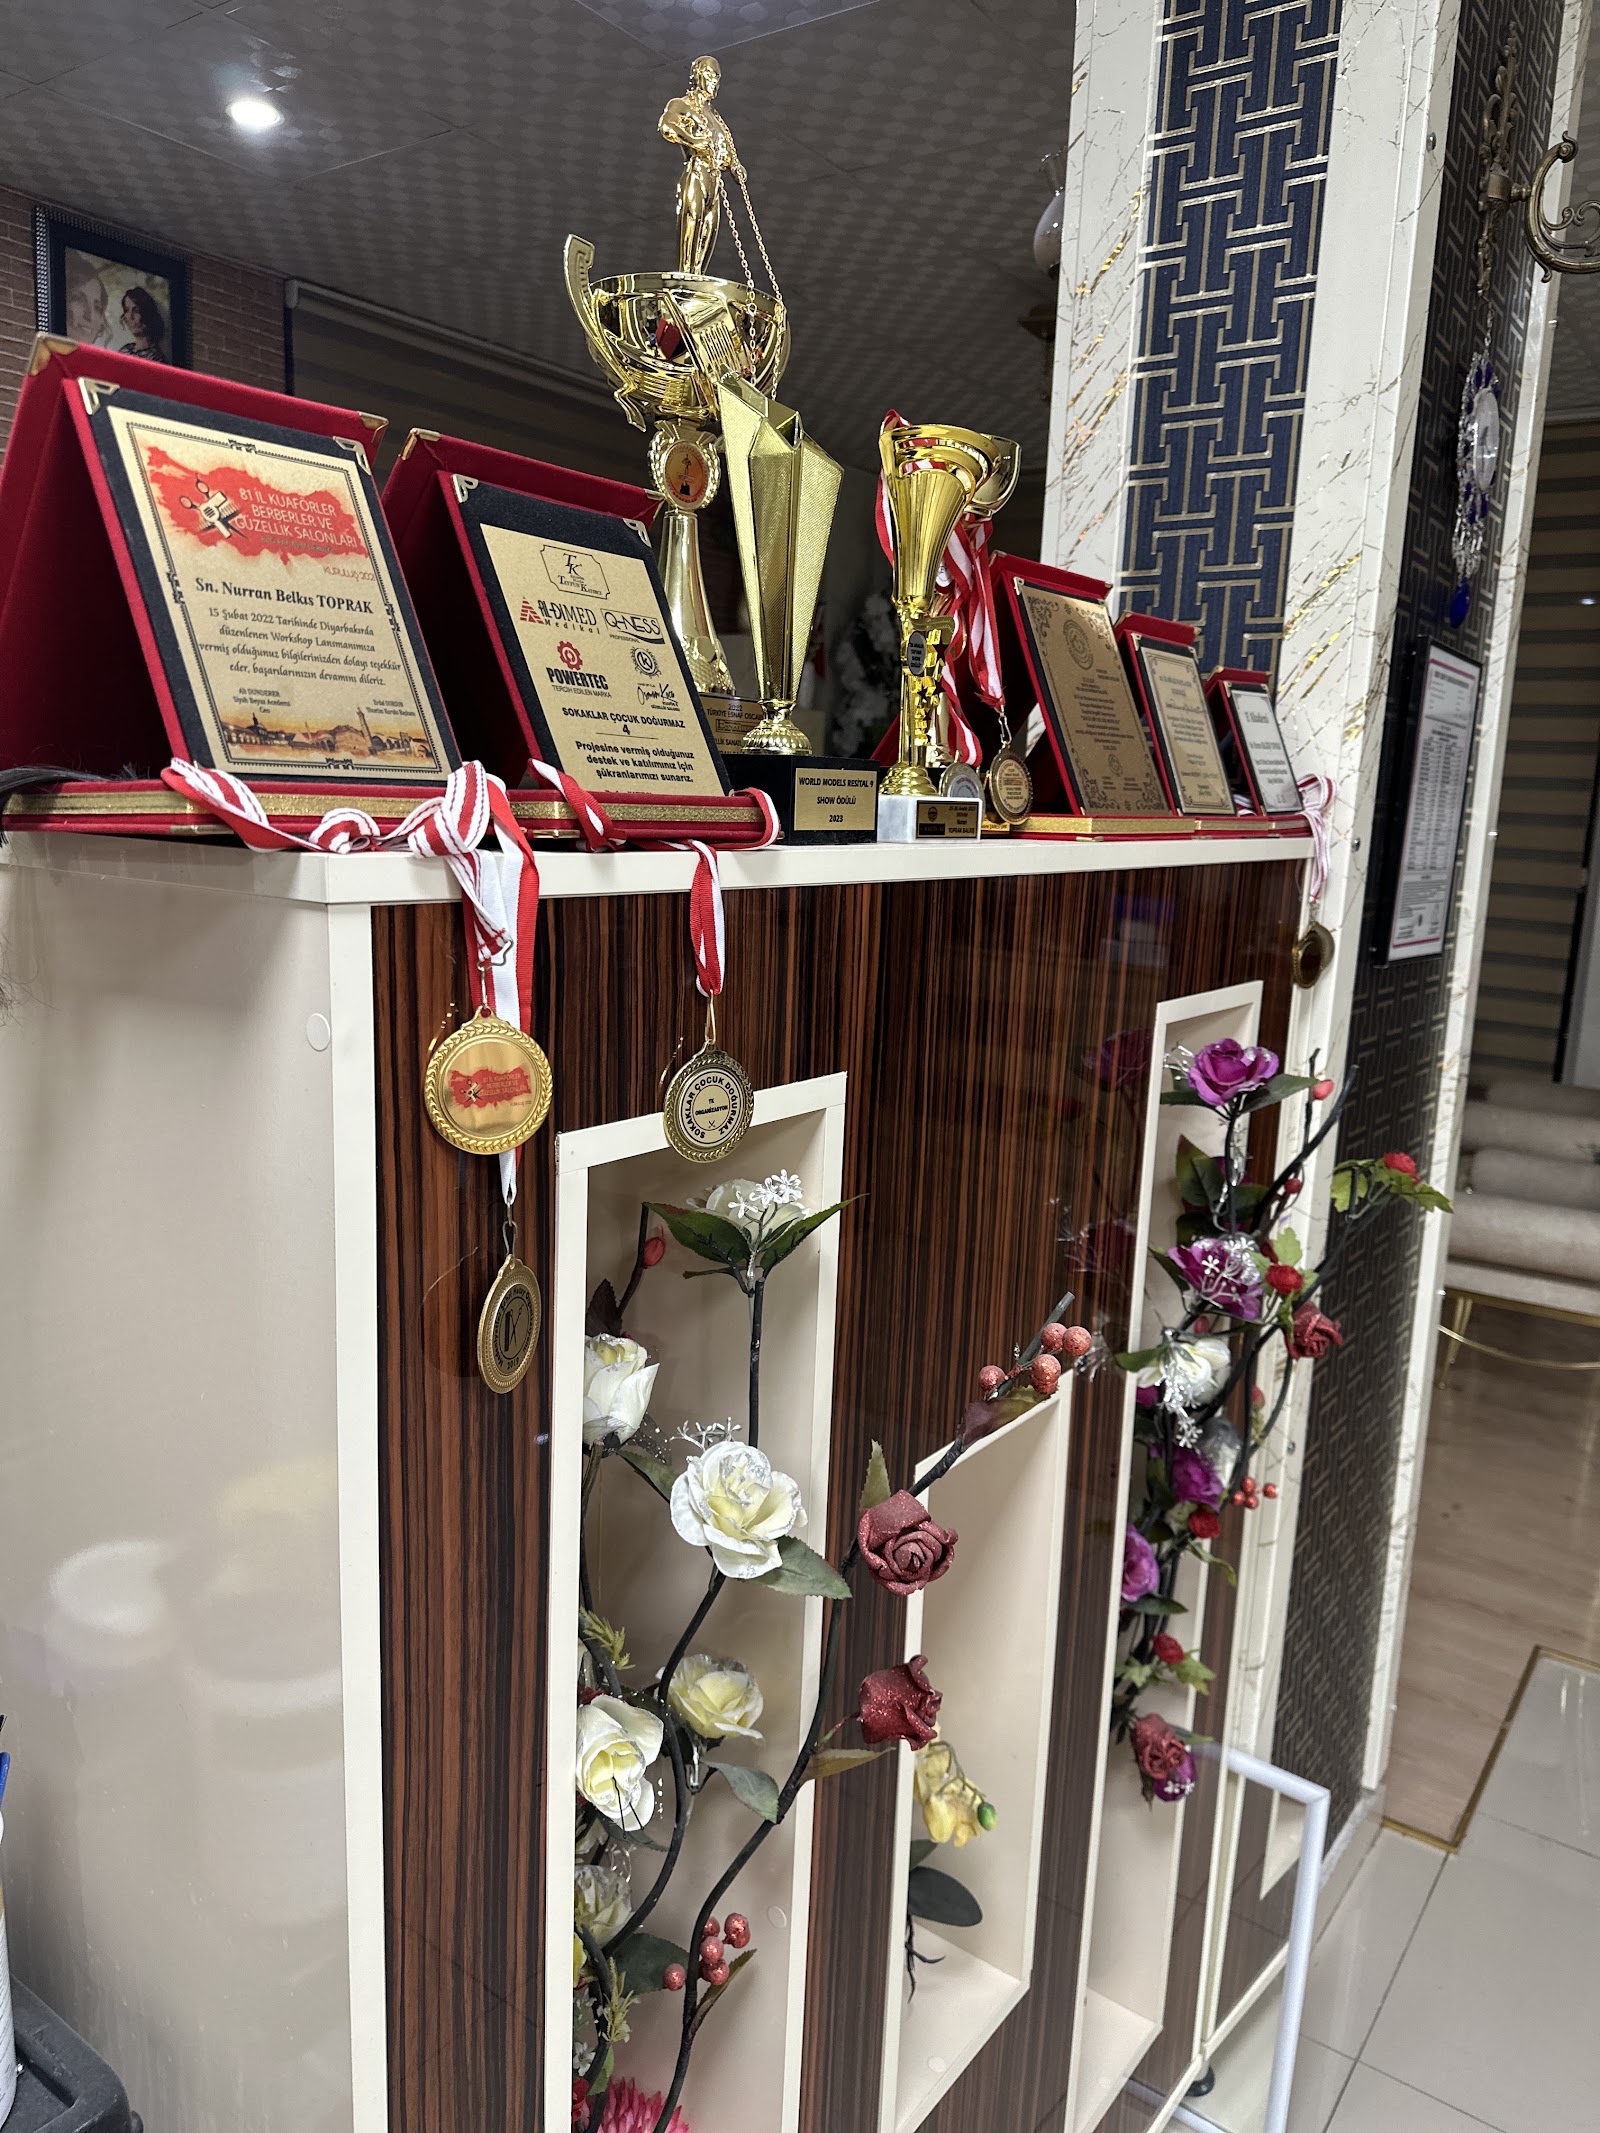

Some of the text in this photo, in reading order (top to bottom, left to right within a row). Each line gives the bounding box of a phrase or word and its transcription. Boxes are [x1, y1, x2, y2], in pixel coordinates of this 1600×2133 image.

[239, 487, 337, 517] 81 İL KUAFÖRLER
[251, 504, 334, 531] BERBERLER VE
[234, 514, 292, 537] GÜZELLİK
[294, 526, 358, 548] SALONLARI
[195, 577, 374, 614] Sn. Nurran Belkıs TOPRAK
[209, 607, 374, 636] 15 Şubat 2022 Tarihinde Diyarbakırda
[544, 619, 600, 634] Medikal
[219, 624, 376, 652] düzenlenen Workshop Lansmanımıza
[199, 643, 402, 671] vermiş olduğunuz bilgilerinizden dolayı teşekkür
[252, 662, 317, 679] başarılarınızın
[319, 669, 358, 683] devamını
[359, 674, 387, 686] dileriz.
[546, 667, 609, 690] POWERTEC
[562, 707, 686, 729] SOKAKLAR ÇOCUK DOĞURMAZ
[622, 724, 631, 736] 4
[575, 740, 695, 760] Projesine vermiş olduğunuz
[586, 754, 694, 773] destek ve katılımınız için
[596, 768, 694, 783] şükranlarımızı sunarız.
[799, 777, 874, 788] WORLD MODELS RESİTAL 9
[817, 795, 857, 805] SHOW ÖDÜLÜ
[829, 814, 844, 823] 2023
[685, 1092, 706, 1139] SOKAKLAR
[718, 1082, 738, 1135] DOĞURMAZ
